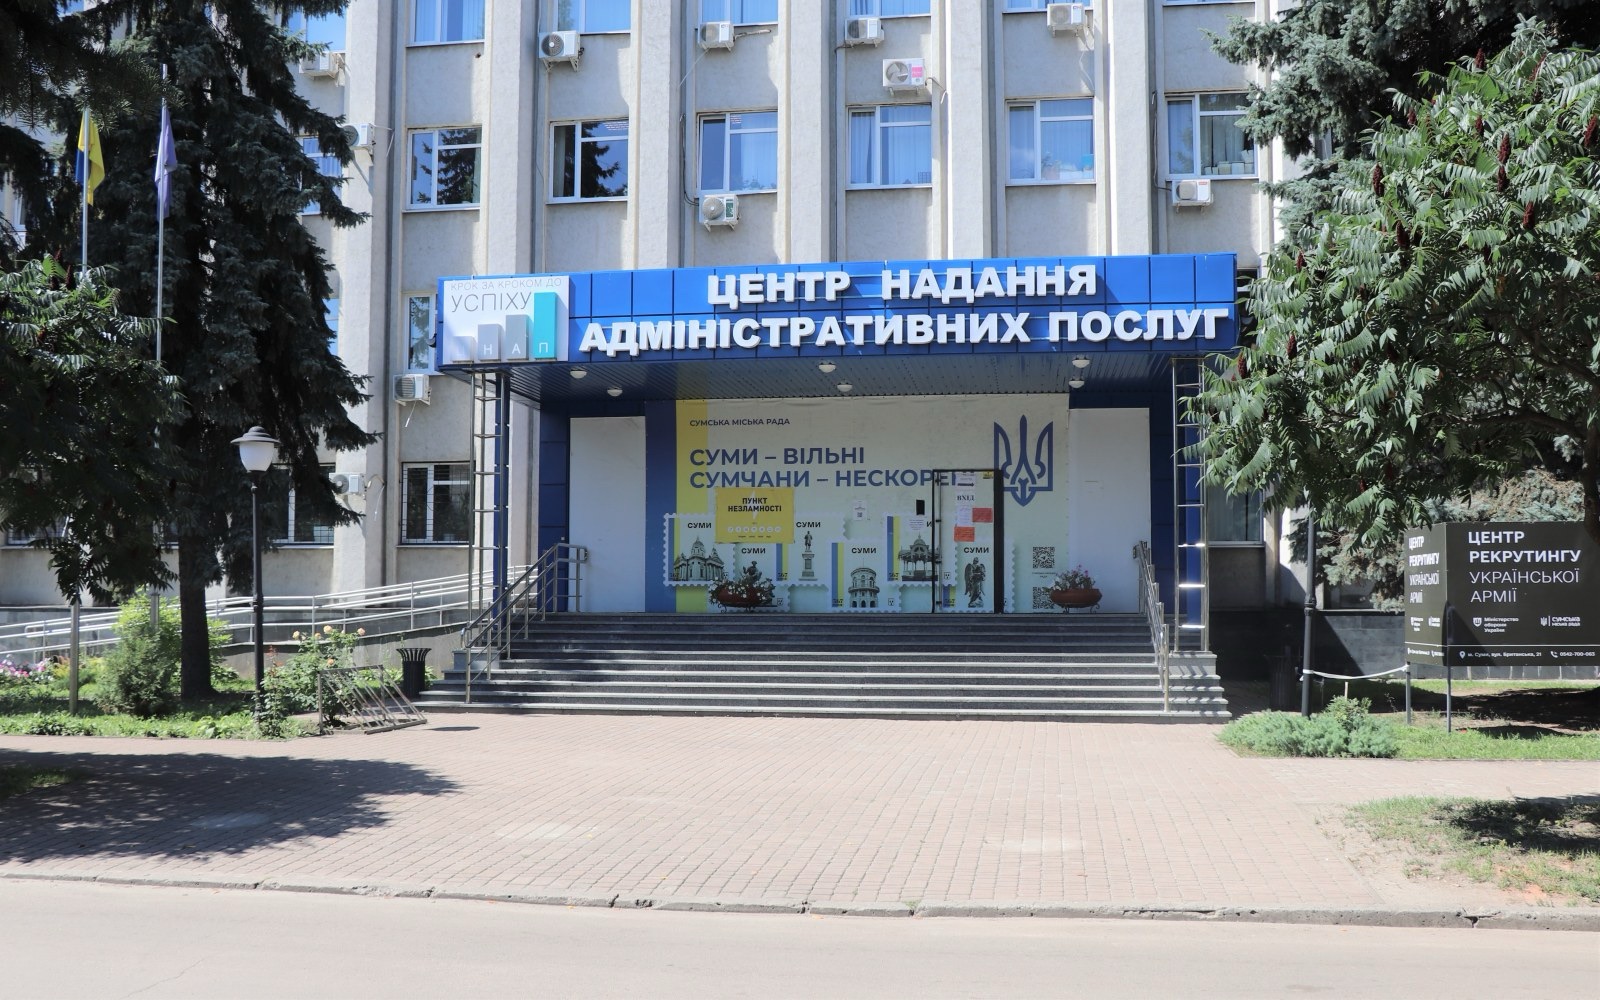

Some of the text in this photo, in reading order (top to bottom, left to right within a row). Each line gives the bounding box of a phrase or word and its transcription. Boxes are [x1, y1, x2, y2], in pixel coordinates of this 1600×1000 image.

[450, 277, 562, 291] КРОК ЗА КРОКОМ ДО
[707, 264, 1097, 310] ЦЕНТР НАДАННЯ
[451, 291, 532, 313] УСПІХУ
[578, 308, 1229, 357] АДМІНІСТРАТИВНИХ ПОСЛУГ
[689, 418, 790, 427] СУМСЬКА МІСЬКА РАДА
[689, 448, 758, 466] СУМИ
[783, 447, 865, 465] ВІЛЬНІ
[689, 470, 810, 489] СУМЧАНИ
[727, 505, 782, 513] НЕЗЛАМНОСТІ
[742, 497, 768, 505] ПУНКТ
[1408, 535, 1425, 551] ЦЕНТР
[1468, 531, 1525, 546] ЦЕНТР
[1408, 552, 1440, 567] РЕКРУТИНГУ
[1469, 550, 1582, 563] РЕКРУТИНГУ
[1469, 568, 1580, 584] УКРАЇНСЬКОЇ
[1470, 587, 1517, 603] АРМІЇ
